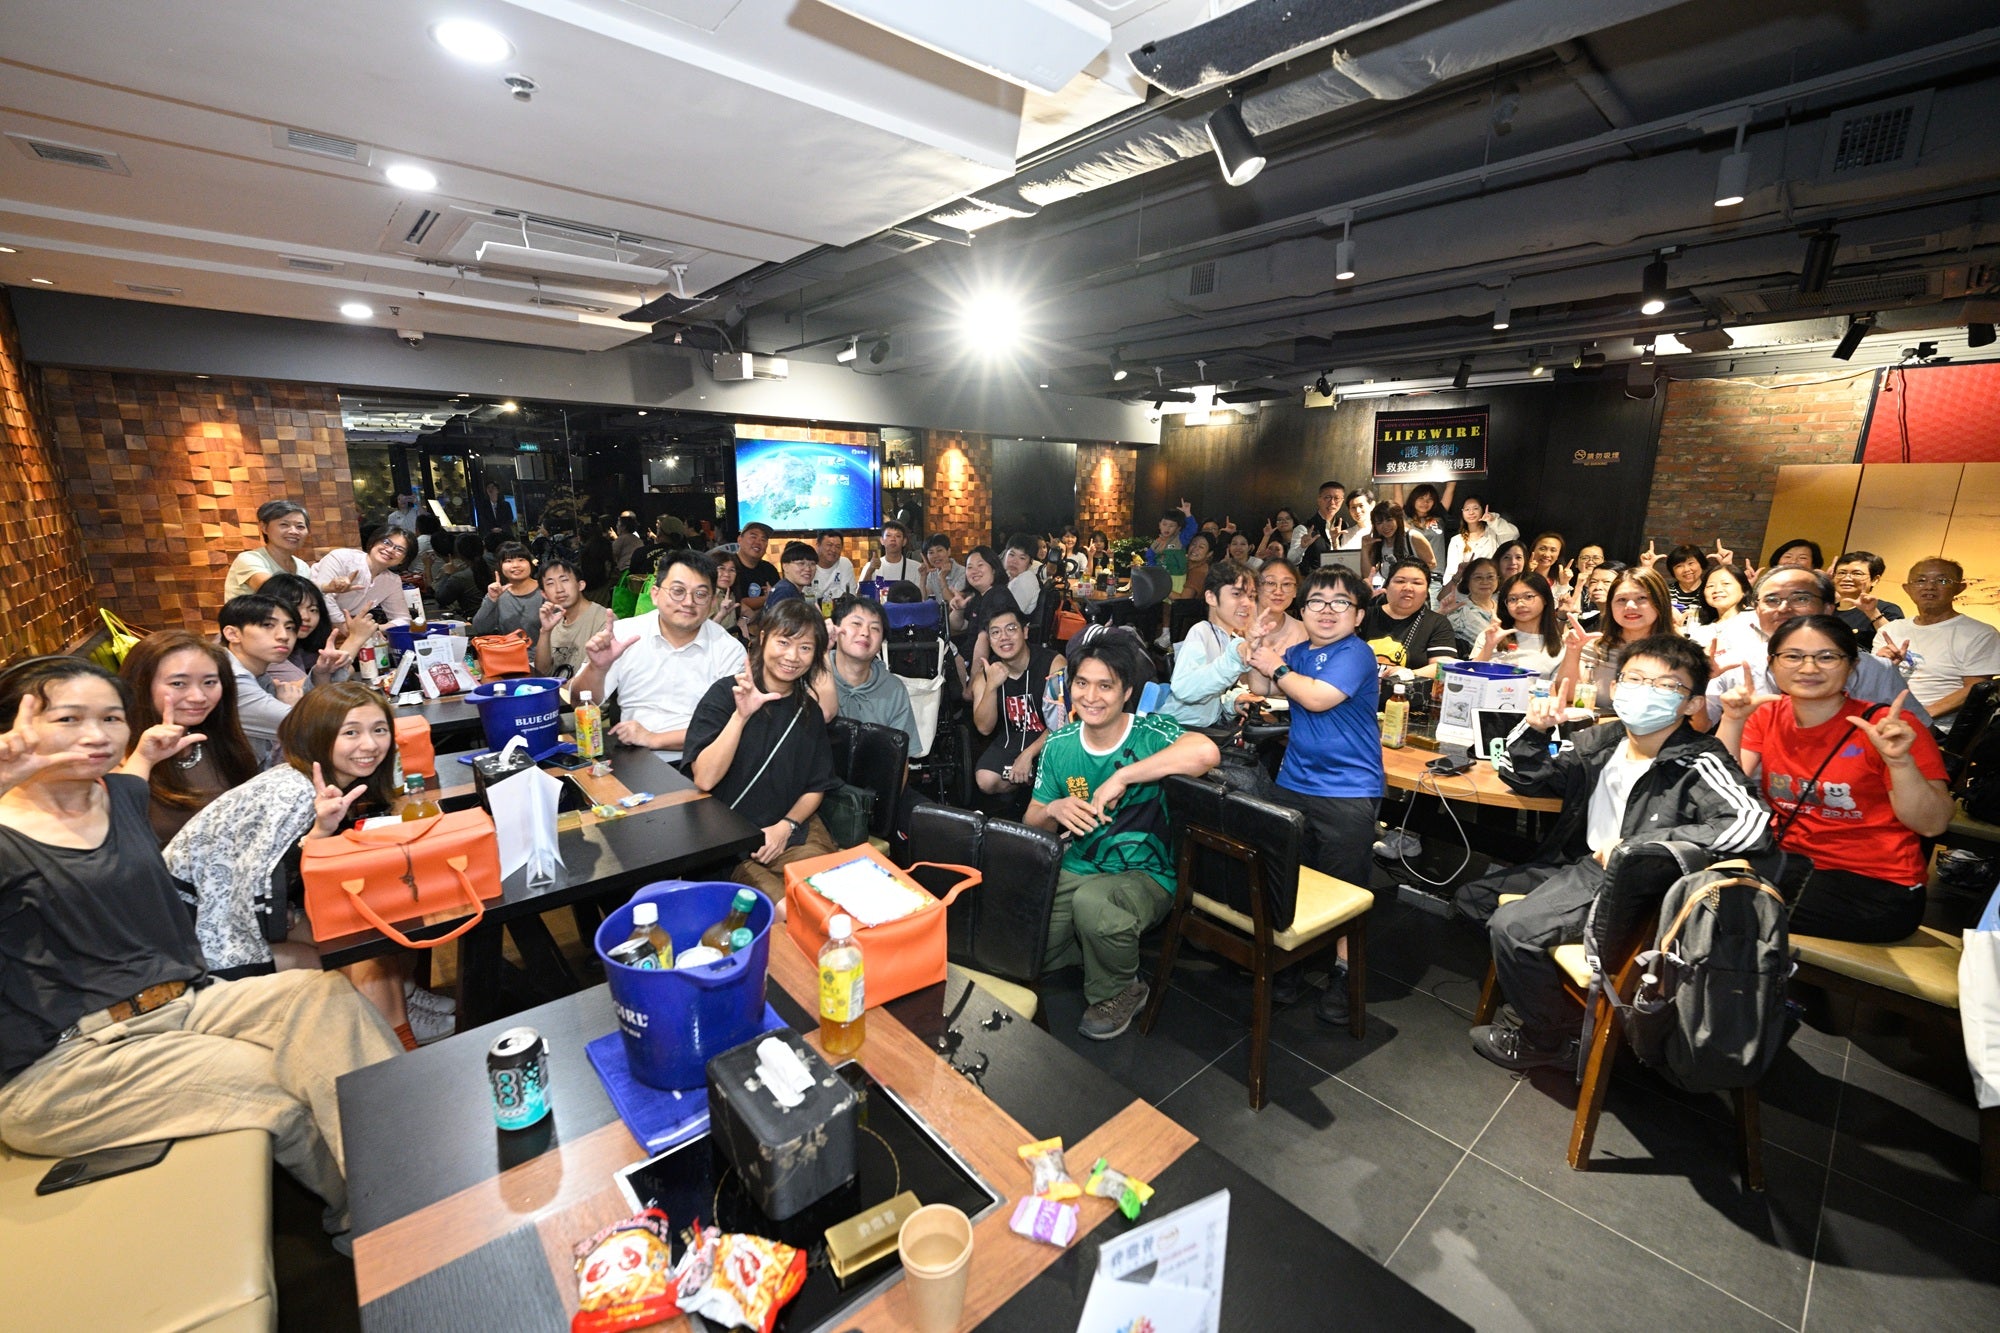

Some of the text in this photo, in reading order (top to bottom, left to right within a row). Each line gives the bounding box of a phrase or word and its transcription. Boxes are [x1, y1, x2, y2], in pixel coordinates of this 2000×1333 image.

[1384, 425, 1481, 442] LIFEWIRE
[515, 715, 542, 726] BLUE
[1822, 808, 1863, 819] BEAR
